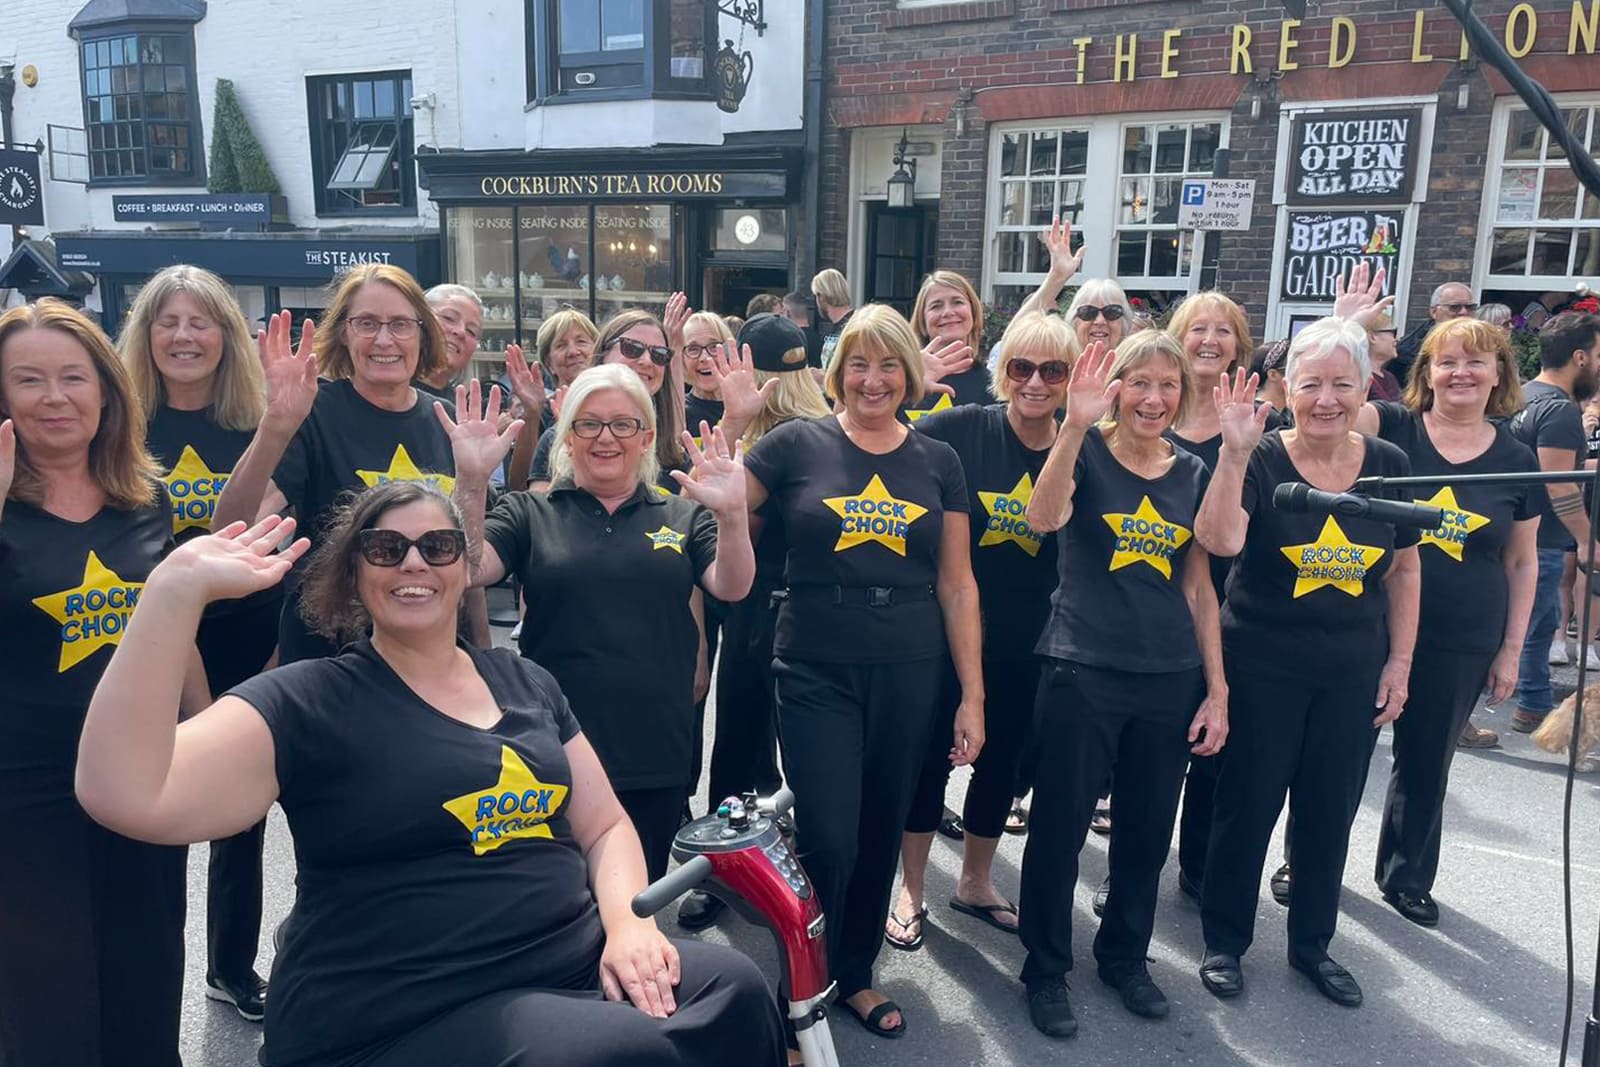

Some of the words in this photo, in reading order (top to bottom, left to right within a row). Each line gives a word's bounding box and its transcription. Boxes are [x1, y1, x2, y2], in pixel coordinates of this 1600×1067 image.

[1073, 28, 1182, 85] THE
[1230, 16, 1358, 75] RED
[1303, 118, 1409, 145] KITCHEN
[1300, 143, 1407, 172] OPEN
[481, 175, 598, 196] COCKBURN'S
[602, 174, 642, 195] TEA
[647, 173, 722, 194] ROOMS
[1211, 181, 1229, 189] Mon
[1235, 181, 1250, 190] Sat
[1297, 174, 1347, 196] ALL
[1350, 168, 1405, 191] DAY
[1187, 186, 1202, 204] P
[1220, 201, 1240, 209] hour
[117, 203, 146, 213] COFFEE
[151, 203, 195, 213] BREAKFAST
[201, 203, 228, 213] LUNCH
[234, 203, 265, 213] DINNER
[1192, 211, 1204, 219] No
[520, 217, 558, 229] SEATING
[560, 217, 588, 229] INSIDE
[596, 216, 636, 229] SEATING
[1290, 215, 1369, 252] BEER
[305, 253, 321, 262] THE
[323, 251, 391, 265] STEAKIST
[1286, 255, 1394, 297] GARDN
[169, 478, 229, 498] OCK
[171, 499, 215, 520] HOI
[843, 499, 907, 520] ROCK
[994, 496, 1028, 515] RO
[840, 516, 909, 539] CHOIR
[1121, 516, 1177, 543] ROCK
[1442, 510, 1471, 528] CK
[1423, 527, 1468, 543] OIR
[1114, 535, 1175, 559] CHOIR
[1301, 545, 1365, 565] ROCK
[1298, 565, 1367, 581] CHOIR
[65, 586, 142, 617] ROCK
[61, 611, 132, 643] CHOI
[475, 788, 554, 822] ROCK
